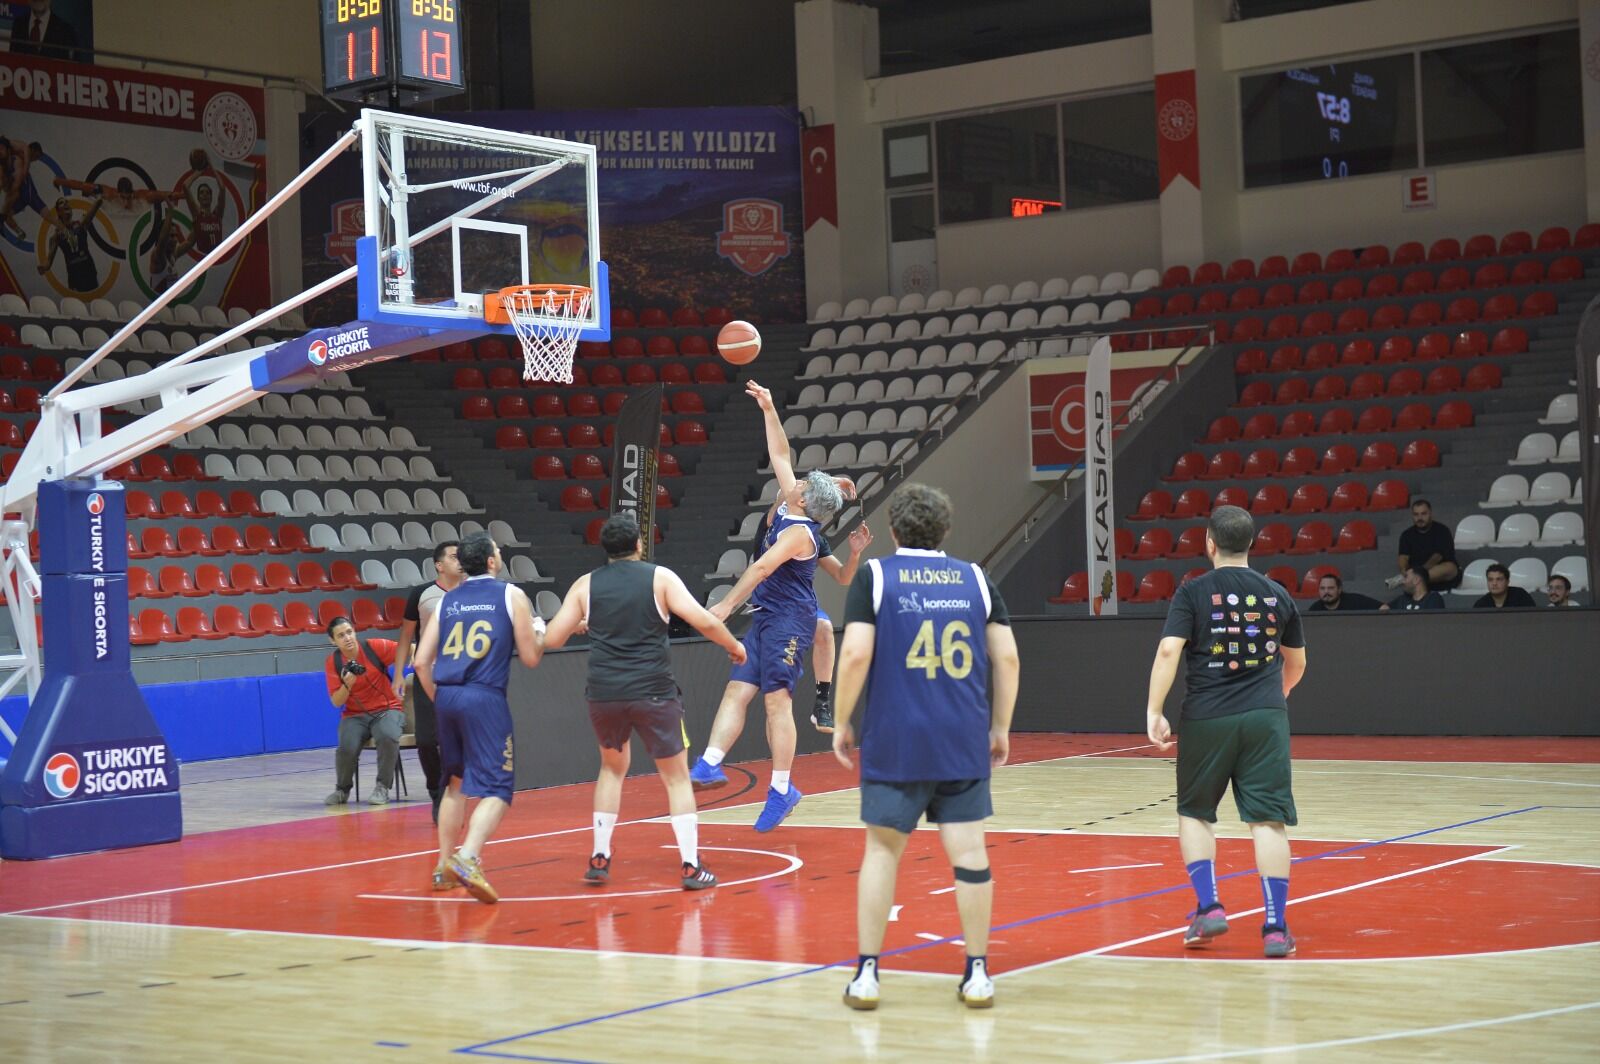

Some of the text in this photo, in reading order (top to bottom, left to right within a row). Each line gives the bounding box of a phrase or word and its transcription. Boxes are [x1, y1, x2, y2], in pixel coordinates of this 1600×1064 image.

[412, 0, 455, 22] 8:56
[346, 26, 378, 81] 11
[57, 72, 109, 110] HER
[113, 80, 195, 120] YERDE
[692, 130, 777, 153] YILDIZI
[620, 157, 654, 169] KADIN
[658, 157, 712, 170] VOLEYBOL
[715, 158, 755, 170] TAKIMI
[452, 181, 516, 199] www.tbf.org.tr
[1410, 177, 1428, 202] E
[442, 619, 493, 660] 46
[906, 619, 973, 680] 46
